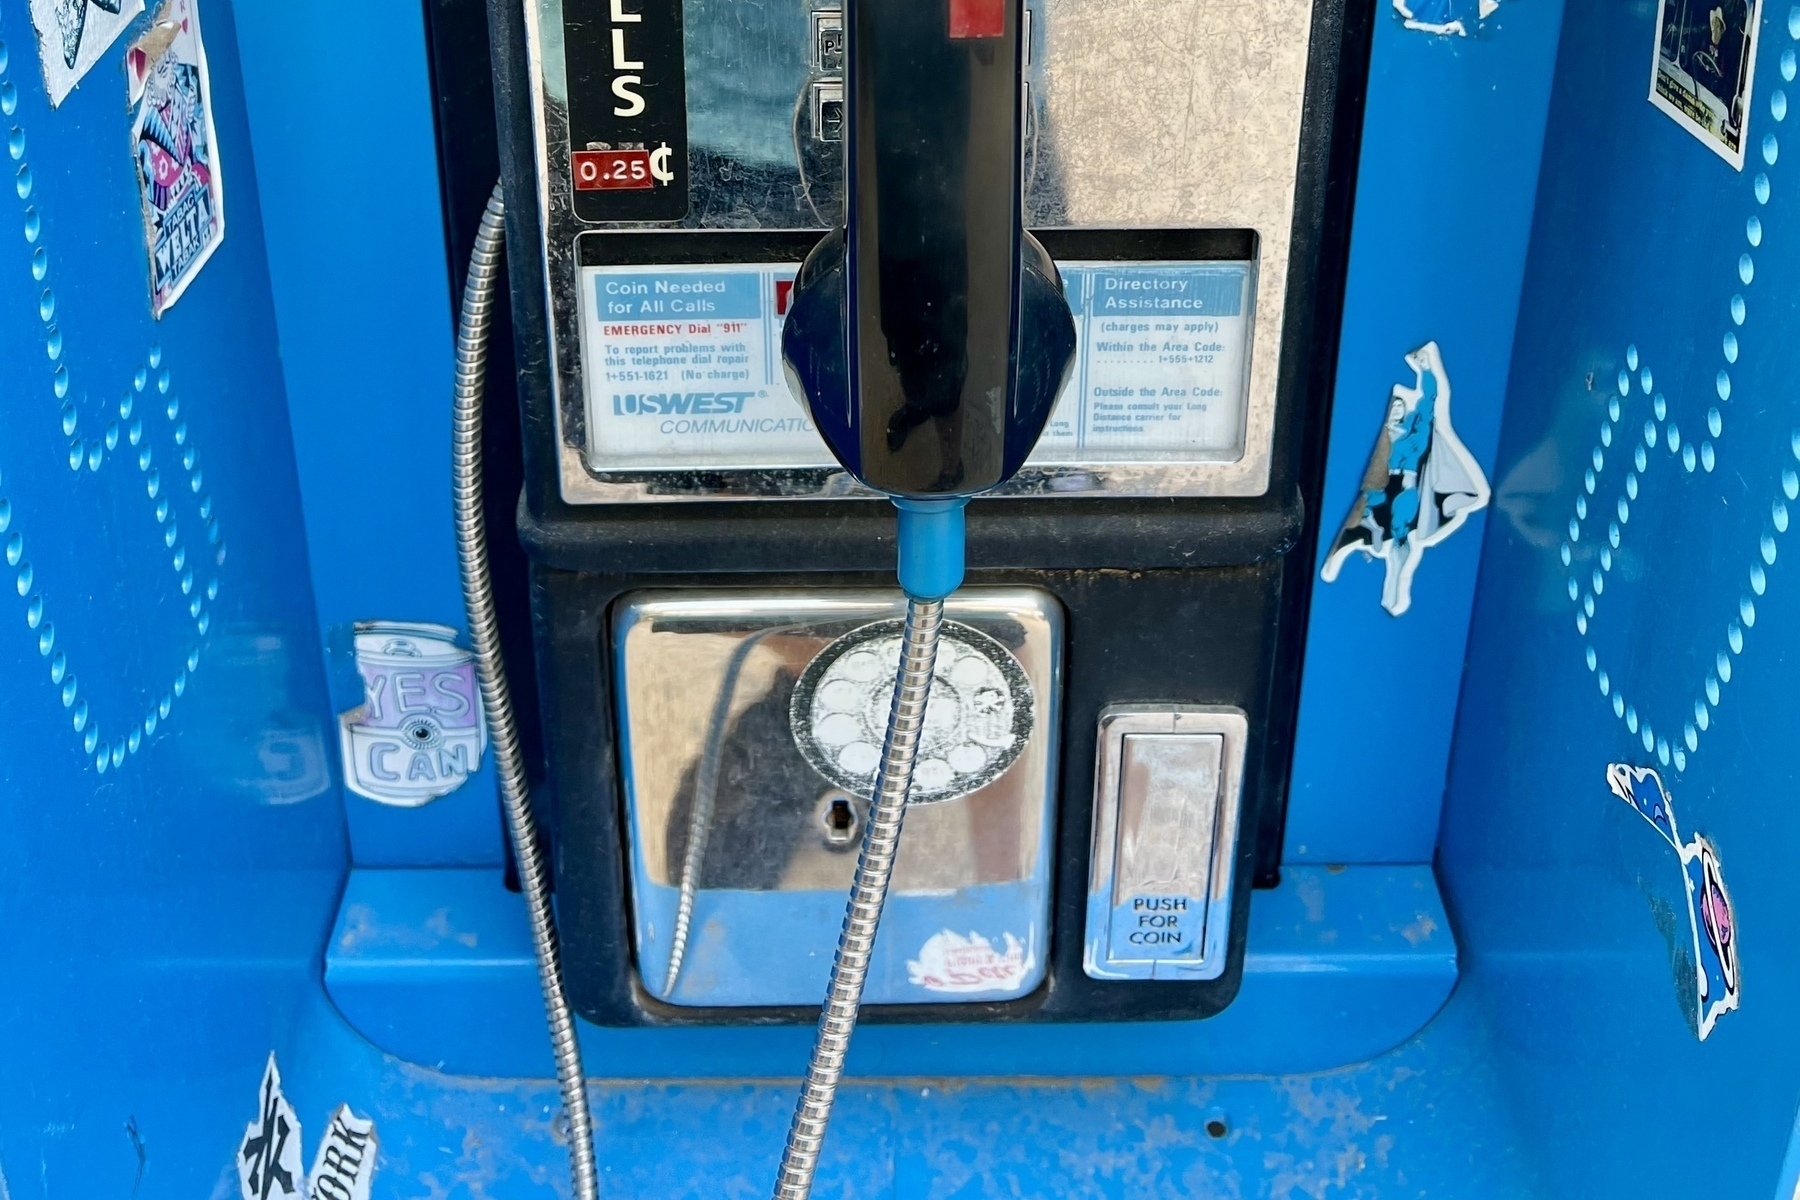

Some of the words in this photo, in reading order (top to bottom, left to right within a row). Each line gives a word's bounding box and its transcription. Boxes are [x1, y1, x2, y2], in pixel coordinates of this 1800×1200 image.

[581, 160, 646, 181] 0.25
[649, 142, 674, 186] ¢
[605, 281, 648, 295] Coin
[655, 280, 726, 294] Needed
[1105, 277, 1188, 292] Directory
[607, 301, 632, 314] for
[640, 300, 664, 312] All
[671, 299, 716, 312] Calls
[1105, 296, 1203, 309] Assistance
[603, 325, 682, 336] EMERGENCY
[688, 323, 711, 334] Dial
[1101, 321, 1150, 333] (charges
[1155, 323, 1179, 333] may
[1184, 321, 1219, 333] apply)
[605, 345, 619, 354] To
[625, 345, 658, 356] report
[664, 343, 716, 355] problems
[721, 343, 746, 352] with
[1096, 342, 1134, 351] Within
[1139, 342, 1157, 351] the
[1163, 342, 1189, 351] Area
[605, 356, 626, 366] this
[632, 355, 687, 367] telephone
[691, 354, 711, 364] dial
[717, 355, 749, 366] repair
[681, 370, 702, 381] (No
[707, 369, 749, 381] charge)
[1094, 387, 1134, 397] Outside
[1139, 387, 1156, 397] the
[1161, 387, 1186, 397] Area
[1094, 402, 1123, 411] Please
[1127, 402, 1160, 411] consult
[1163, 403, 1182, 412] your
[1187, 402, 1207, 412] Long
[1093, 413, 1131, 421] Distance
[1135, 413, 1164, 421] carrier
[1168, 413, 1181, 421] for
[367, 672, 470, 721] YES
[369, 741, 467, 782] CAN
[1134, 898, 1186, 911] PUSH
[1139, 915, 1178, 928] FOR
[1129, 932, 1181, 944] COIN
